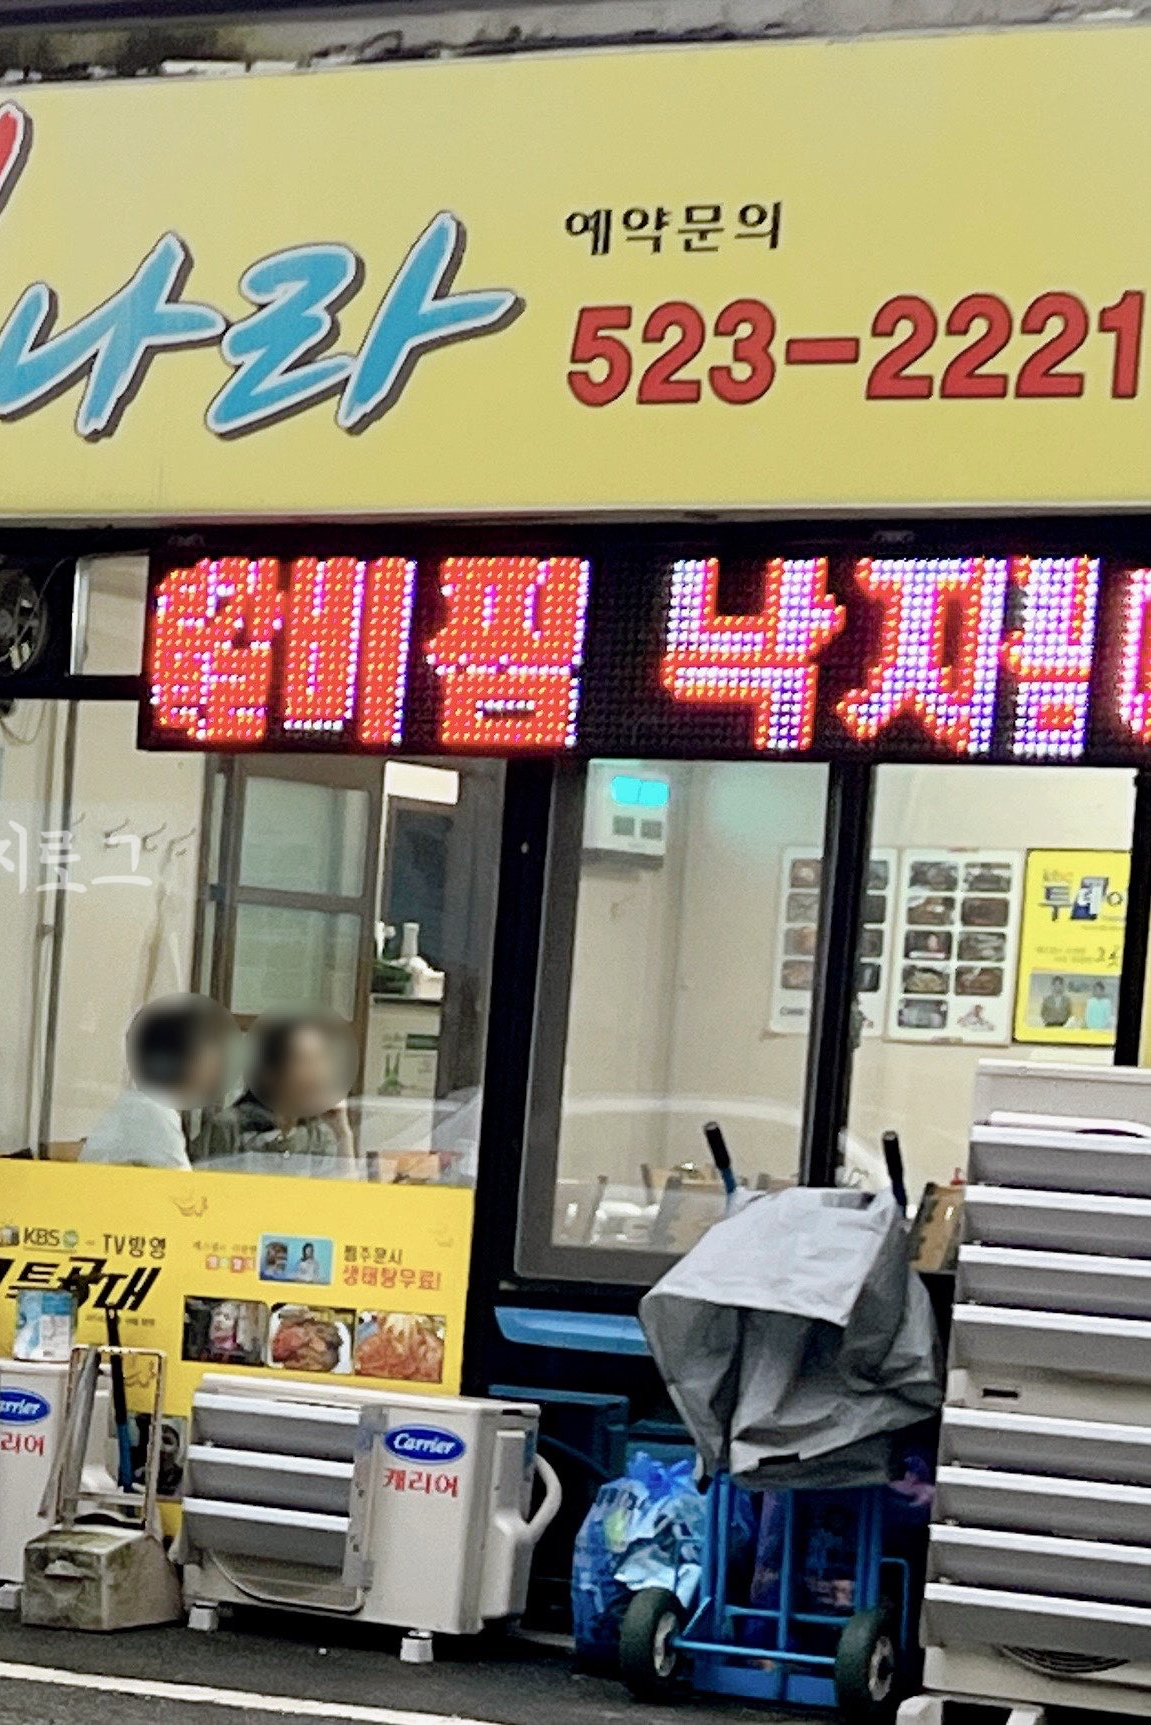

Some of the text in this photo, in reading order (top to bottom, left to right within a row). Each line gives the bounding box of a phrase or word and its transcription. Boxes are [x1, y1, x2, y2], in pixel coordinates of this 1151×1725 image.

[565, 202, 782, 255] 예약문의
[568, 290, 1146, 407] 523-2221
[23, 1226, 60, 1246] KBS
[0, 1431, 46, 1457] 리어
[393, 1432, 457, 1455] Carrier
[383, 1467, 459, 1498] 캐리어
